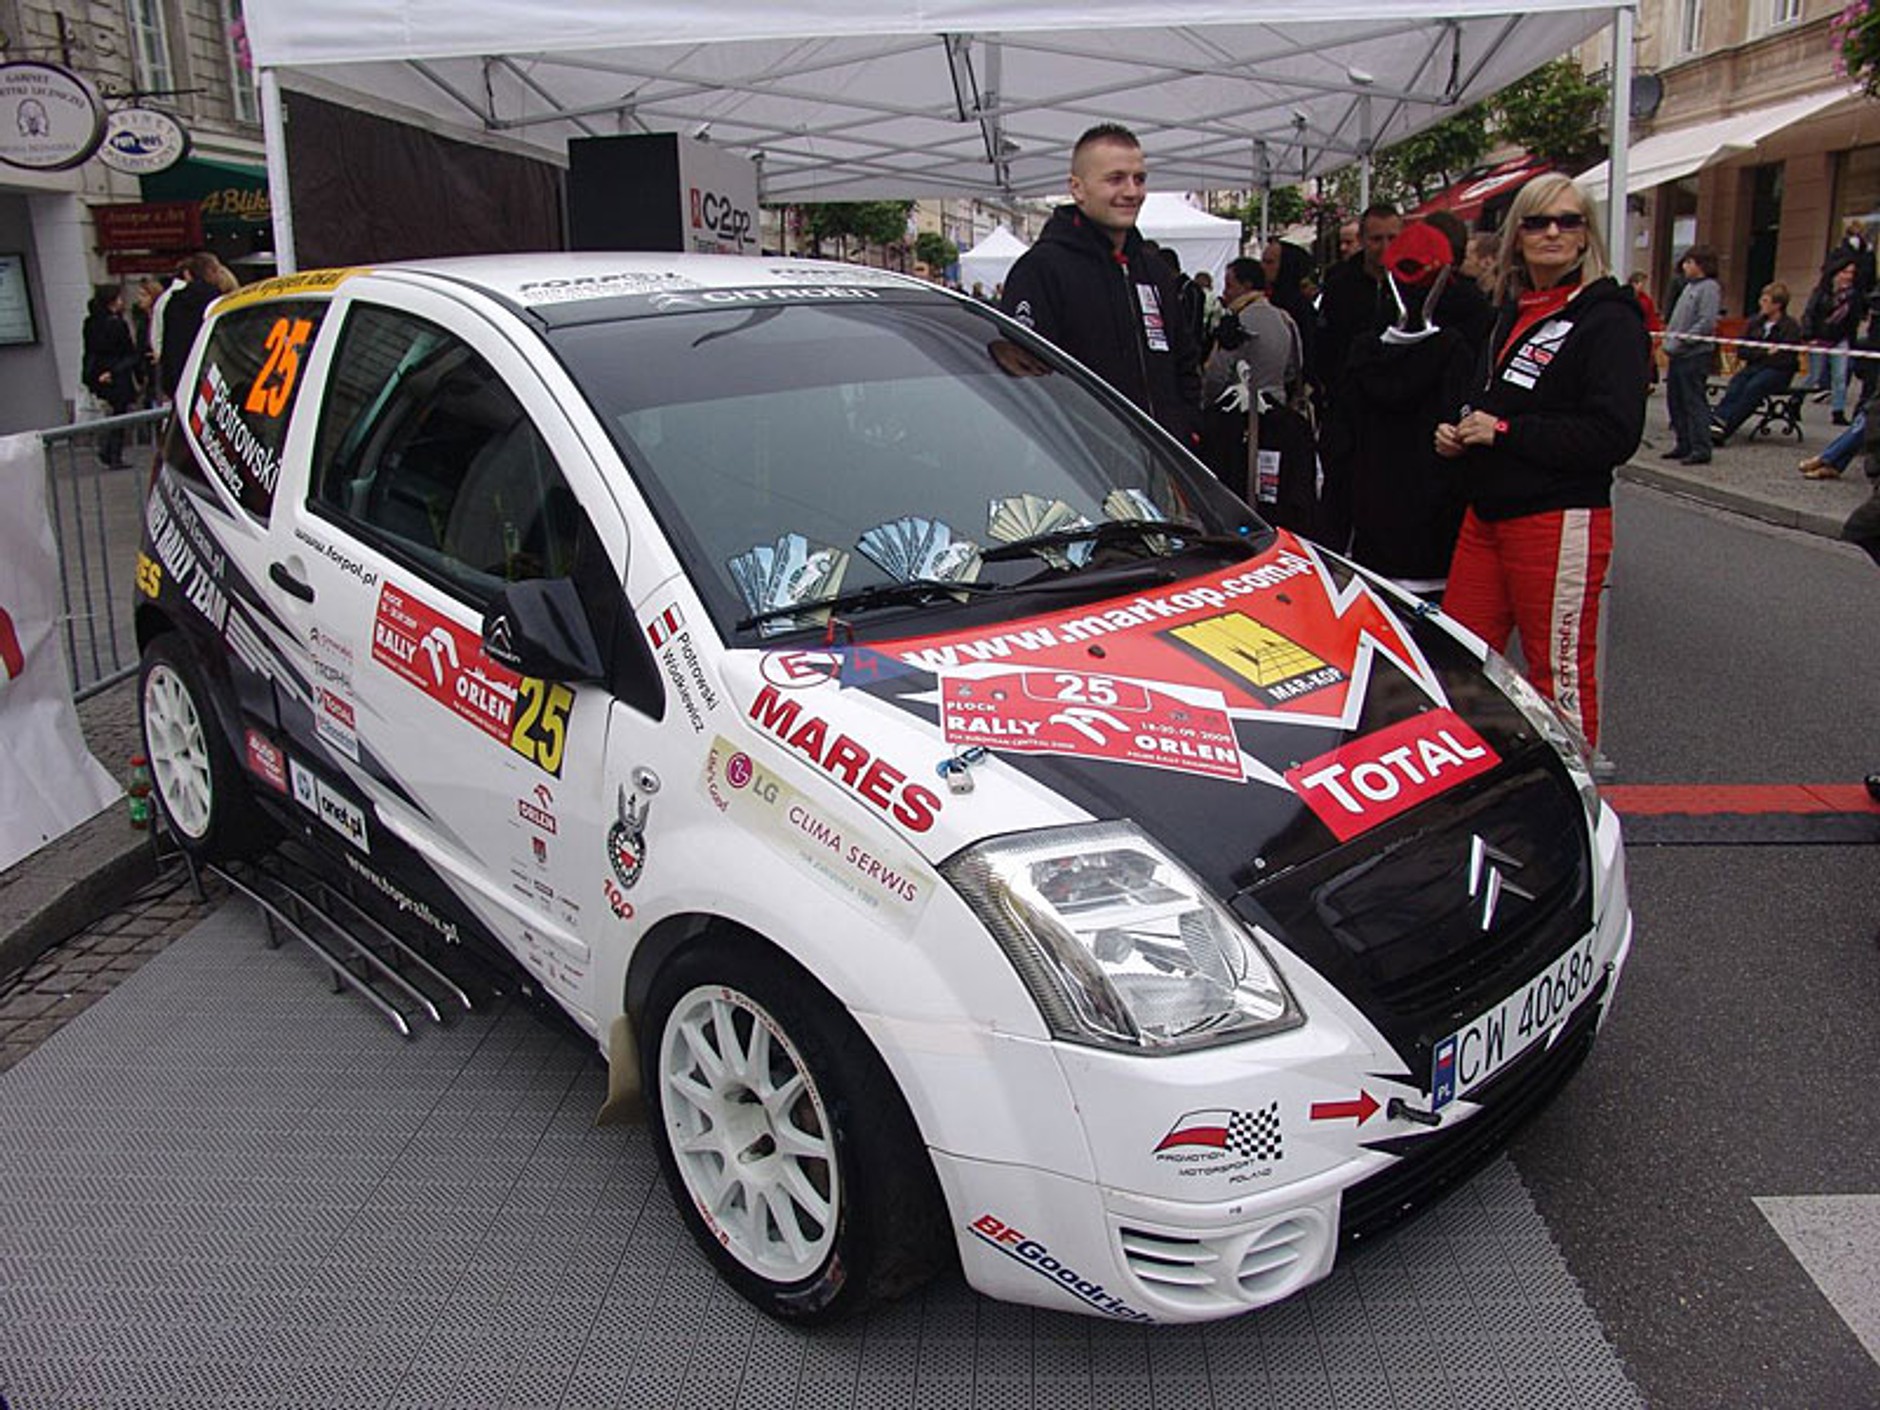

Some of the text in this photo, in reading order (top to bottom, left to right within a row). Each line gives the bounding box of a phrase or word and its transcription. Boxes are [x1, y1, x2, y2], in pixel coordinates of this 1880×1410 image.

[245, 317, 312, 418] 25
[210, 379, 283, 495] Piotrowski
[155, 517, 197, 584] RALLY
[185, 562, 229, 632] TEAM
[294, 528, 377, 587] www.forpol.pl
[376, 622, 417, 664] RALLY
[902, 549, 1313, 671] www.markop.com.pl
[456, 675, 511, 725] ORLEN
[677, 631, 720, 711] Piotrowski
[1054, 674, 1118, 706] 25
[1267, 667, 1343, 700] MAR-KOP
[511, 677, 573, 773] 25
[749, 684, 942, 834] MARES
[947, 714, 1041, 736] RALLY
[1134, 735, 1238, 764] ORLEN
[752, 777, 780, 804] LG
[1301, 730, 1487, 813] TOTAL
[521, 803, 555, 833] ORLEN
[789, 806, 841, 852] CLIMA
[846, 846, 918, 902] SERWIS
[1459, 939, 1594, 1085] CW 40686
[1156, 1151, 1226, 1161] PROMOTION
[1179, 1159, 1256, 1176] MOTORSPORT
[973, 1214, 1156, 1323] BFGoodrich
